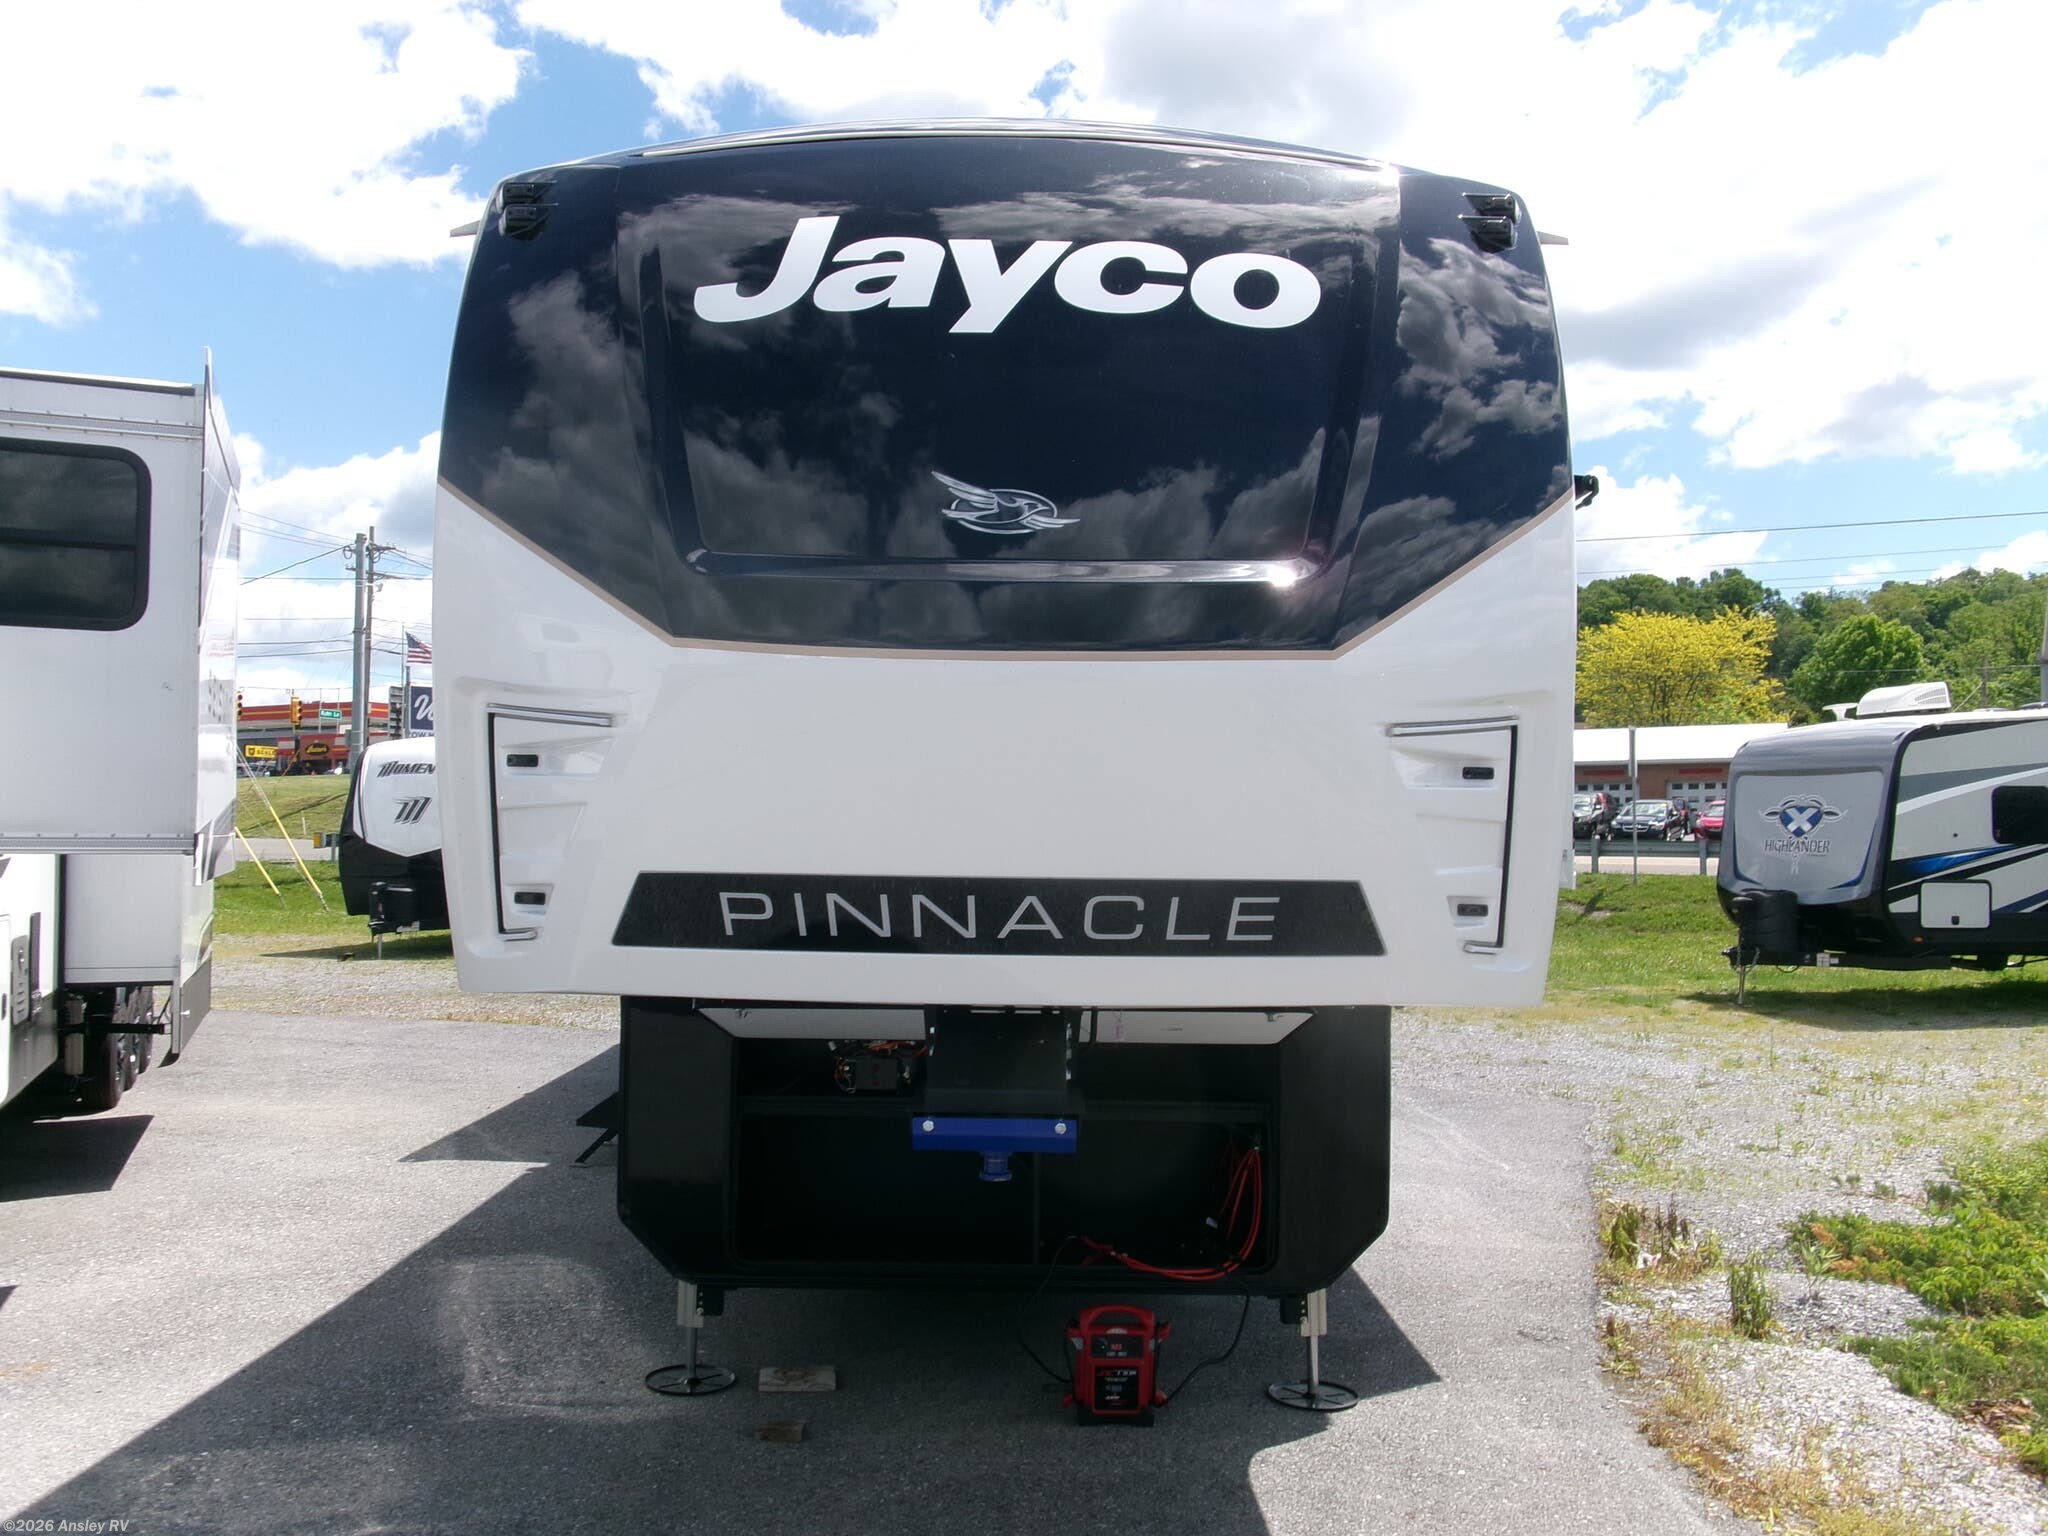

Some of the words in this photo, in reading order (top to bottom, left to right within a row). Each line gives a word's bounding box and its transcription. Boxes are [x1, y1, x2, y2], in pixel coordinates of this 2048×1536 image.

[694, 215, 1321, 333] Jayco
[1764, 839, 1831, 853] HIGHLANDER
[719, 892, 1281, 942] PINNACLE
